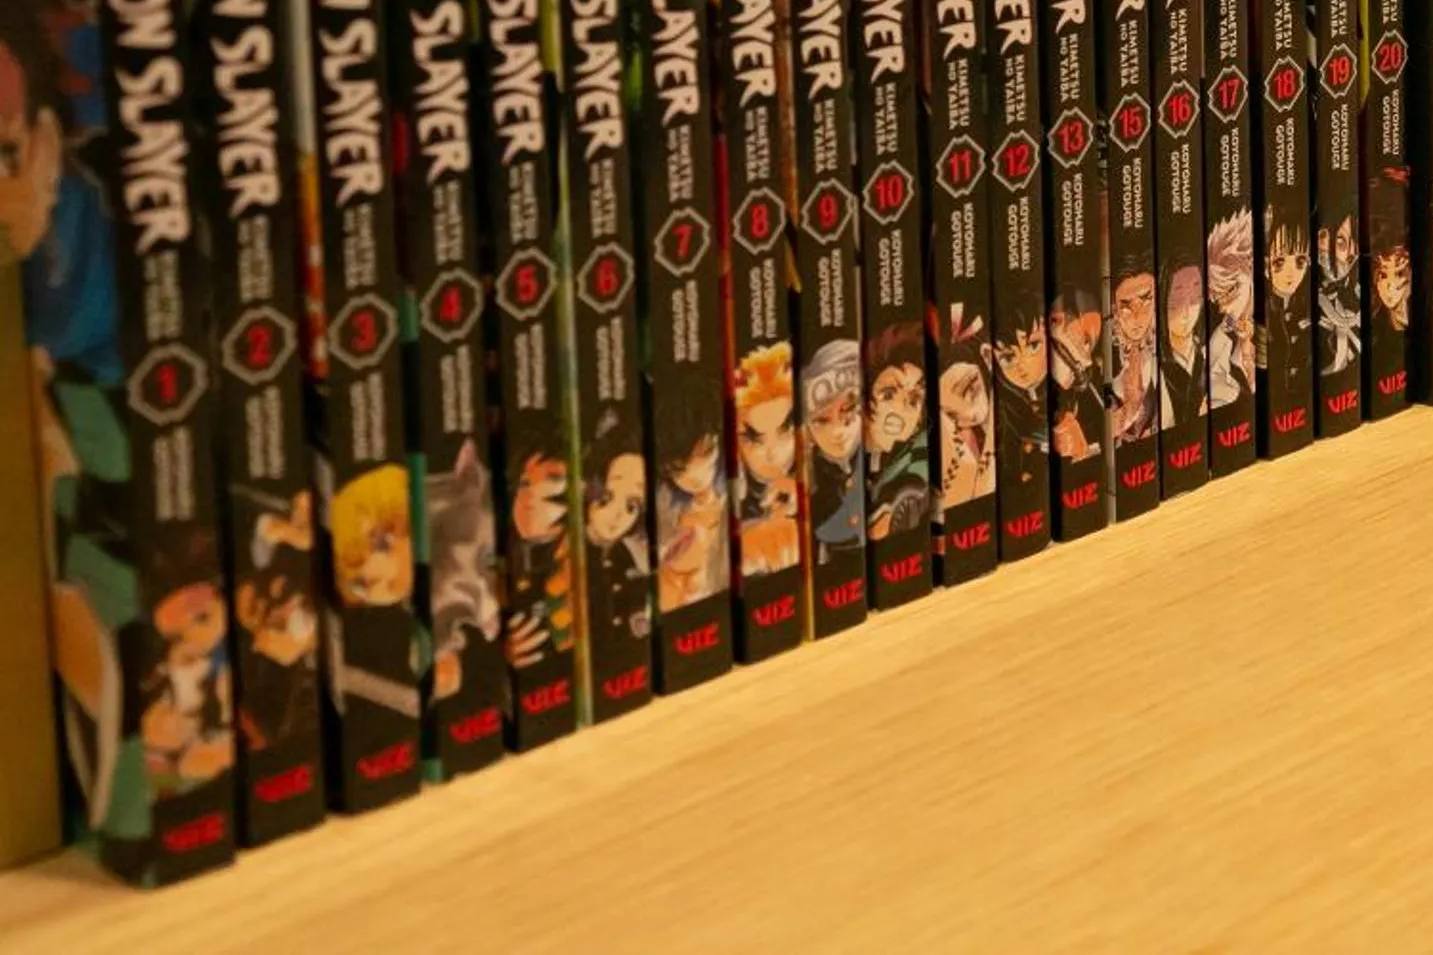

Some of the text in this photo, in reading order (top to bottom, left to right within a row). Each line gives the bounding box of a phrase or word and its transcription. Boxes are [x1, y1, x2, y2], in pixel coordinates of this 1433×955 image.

[1129, 20, 1139, 84] KIMETSU
[1178, 9, 1187, 71] KIMETSU
[1069, 34, 1080, 99] KIMETSU
[1328, 56, 1350, 85] 19
[1379, 43, 1403, 72] 20
[410, 0, 471, 184] SLAYER
[958, 59, 970, 126] KIMETSU
[1015, 55, 1026, 121] KIMETSU
[1218, 77, 1242, 109] 17
[1273, 67, 1297, 100] 18
[211, 25, 280, 220] SLAYER
[320, 19, 383, 207] SLAYER
[886, 83, 898, 152] KIMETSU
[1118, 106, 1144, 139] 15
[1167, 91, 1192, 125] 16
[1058, 119, 1086, 155] 13
[116, 56, 191, 256] SLAYER
[948, 150, 972, 180] 11
[1003, 143, 1032, 177] 12
[873, 174, 904, 210] 10
[749, 202, 771, 239] 8
[817, 193, 839, 230] 9
[672, 223, 694, 257] 7
[515, 265, 540, 304] 5
[247, 326, 271, 366] 2
[353, 311, 376, 351] 3
[1377, 370, 1406, 395] VIZ
[1327, 389, 1357, 415] VIZ
[1216, 420, 1252, 449] VIZ
[1271, 407, 1307, 433] VIZ
[1168, 442, 1201, 468] VIZ
[1121, 460, 1157, 489] VIZ
[1062, 482, 1097, 509] VIZ
[947, 522, 990, 551] VIZ
[1003, 511, 1042, 538] VIZ
[880, 554, 922, 583] VIZ
[751, 595, 797, 627] VIZ
[822, 578, 865, 610] VIZ
[673, 623, 719, 656] VIZ
